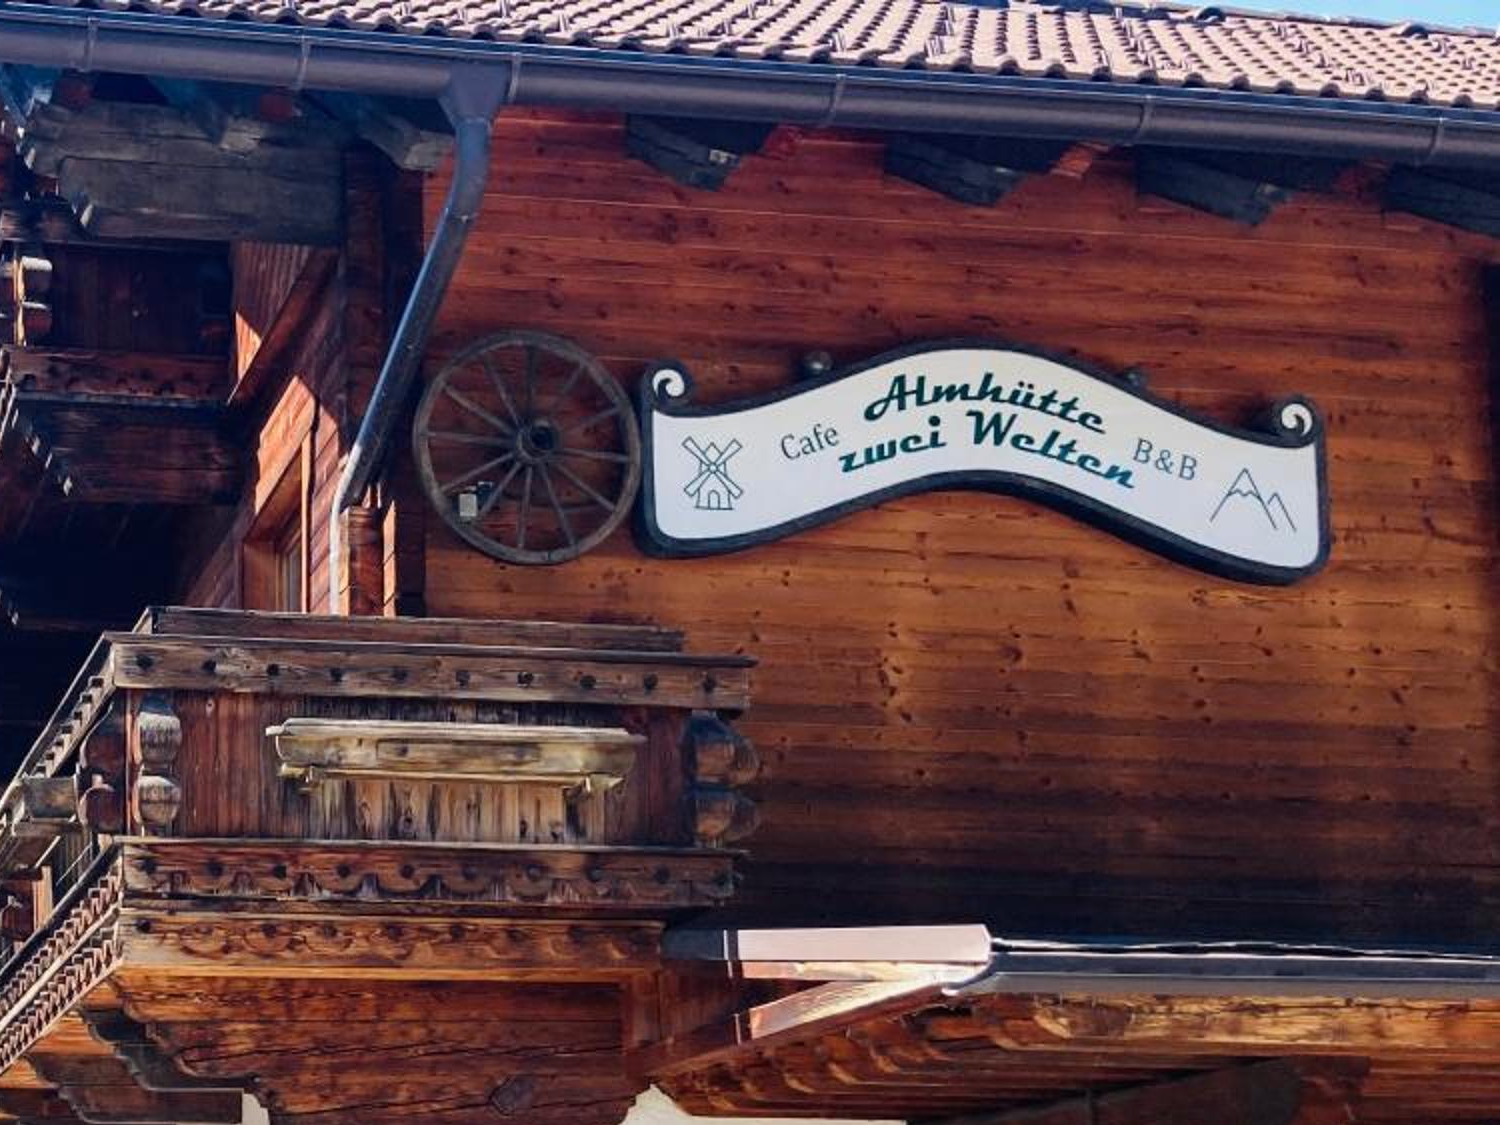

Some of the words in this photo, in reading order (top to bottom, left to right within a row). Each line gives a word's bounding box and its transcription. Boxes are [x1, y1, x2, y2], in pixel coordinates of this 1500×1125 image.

[864, 373, 1105, 434] Almhütte
[781, 424, 840, 461] Cafe
[839, 416, 946, 473] zwei
[967, 410, 1135, 488] Welten
[1133, 438, 1198, 480] B&B
